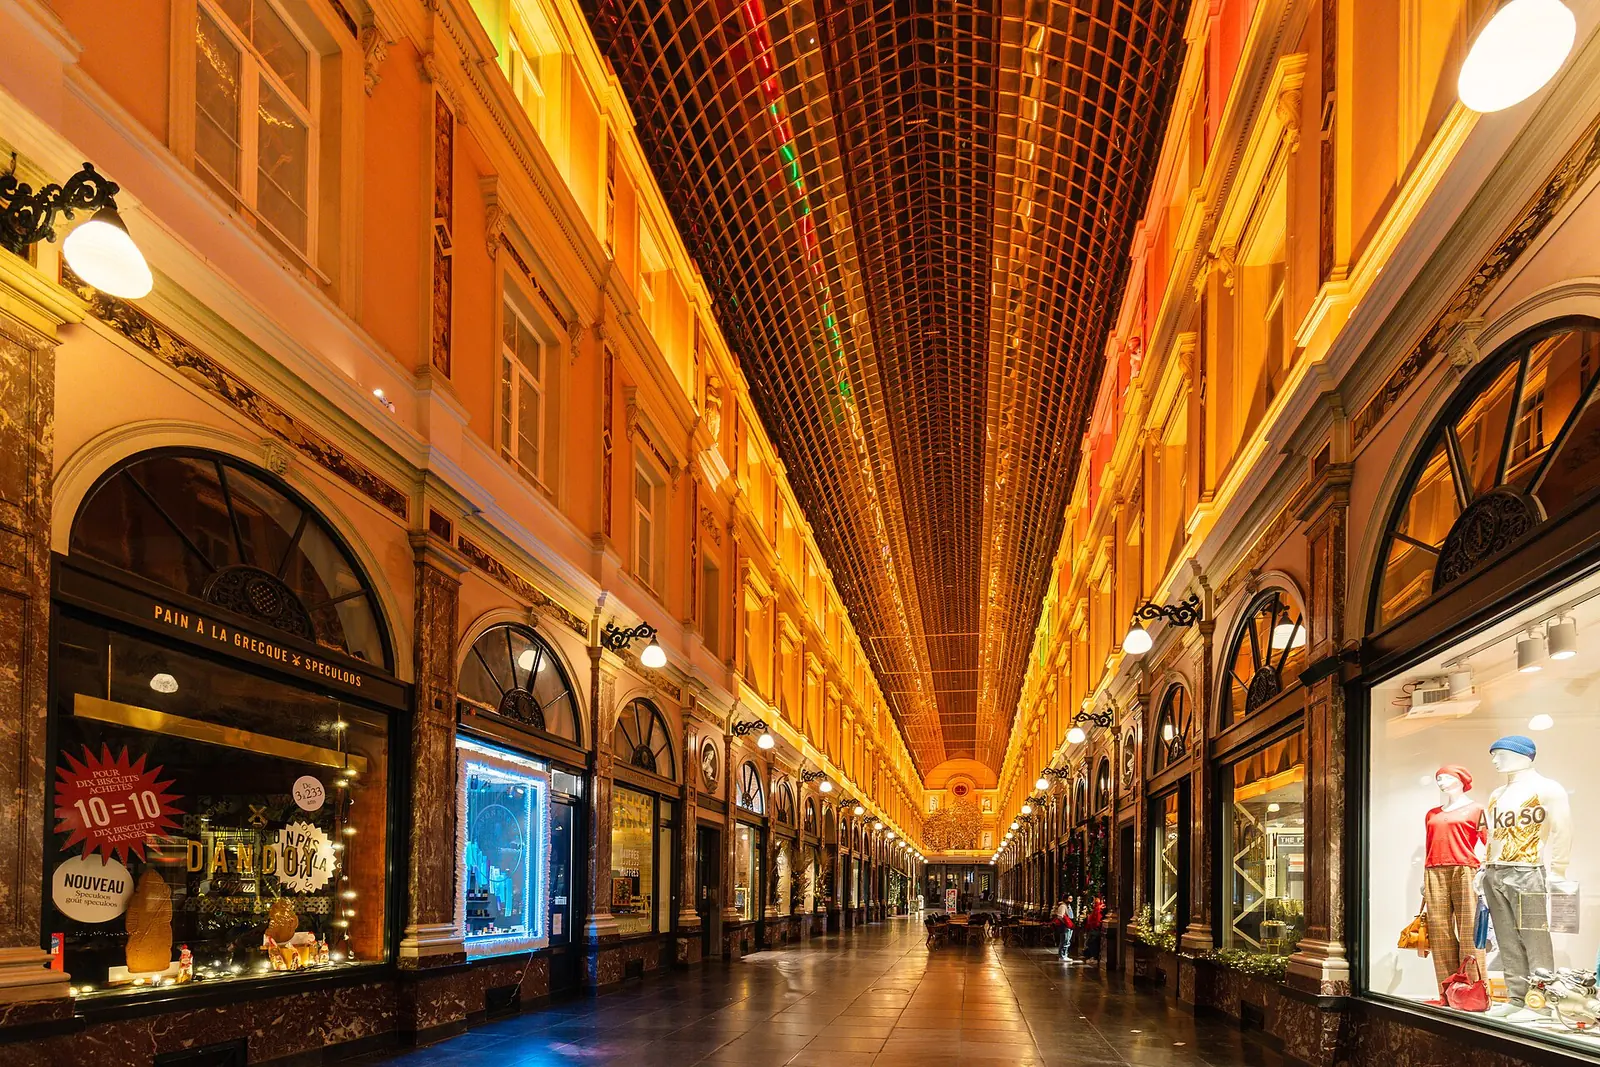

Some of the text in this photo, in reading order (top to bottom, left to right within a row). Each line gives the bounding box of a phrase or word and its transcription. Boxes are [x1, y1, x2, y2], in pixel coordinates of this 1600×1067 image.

[154, 605, 362, 687] PAIN À LA GRECQUE SPECULOOS
[76, 775, 140, 788] DIX BISCUITS
[92, 769, 120, 779] POUR
[1477, 805, 1546, 830] Akaso
[93, 821, 155, 838] DIX BISCUITS
[186, 839, 317, 879] DANDOY
[64, 873, 125, 894] NOUVEAU
[75, 890, 111, 900] Speculoos
[84, 899, 118, 908] speculoos
